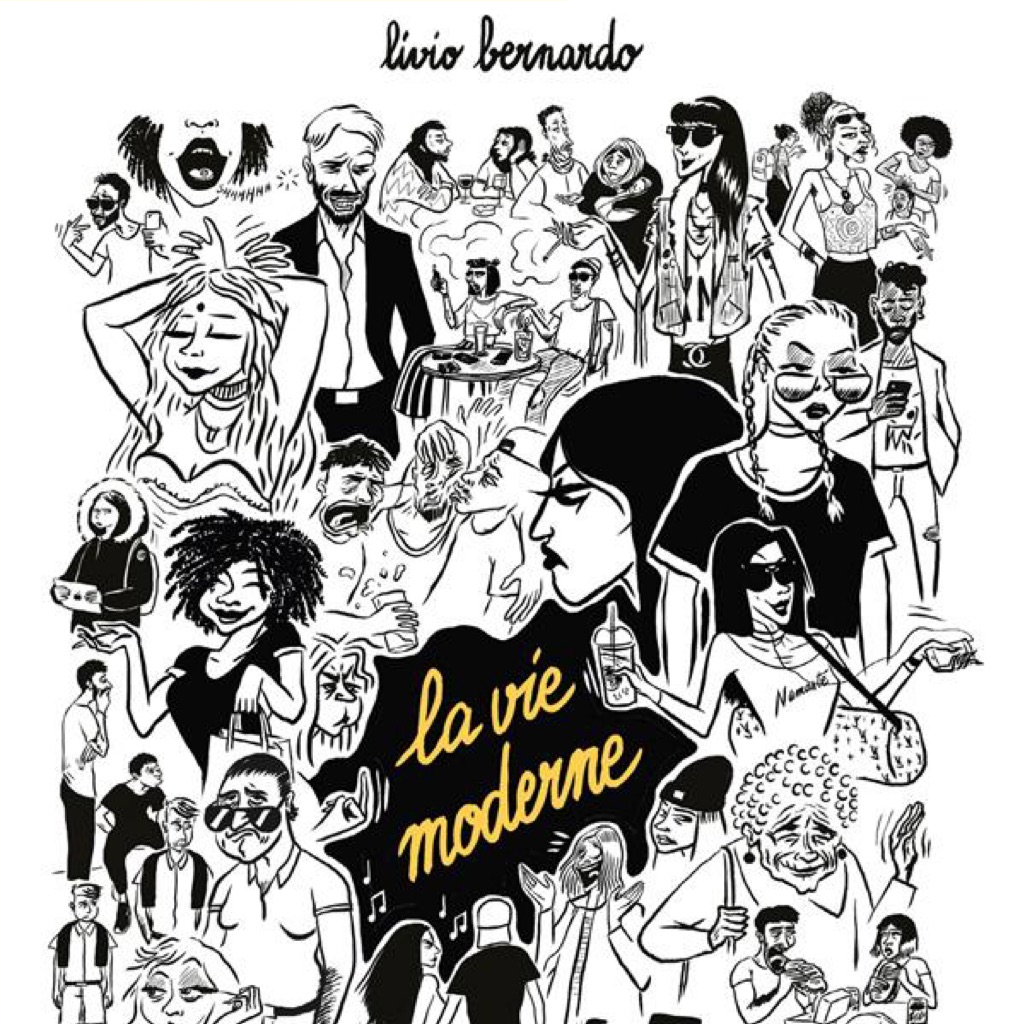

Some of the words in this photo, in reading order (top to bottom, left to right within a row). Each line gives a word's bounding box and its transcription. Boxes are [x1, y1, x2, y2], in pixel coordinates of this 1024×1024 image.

[380, 19, 464, 71] livio
[472, 14, 645, 72] bernardo
[396, 668, 484, 767] la
[491, 648, 576, 734] vie
[398, 734, 643, 882] moderne
